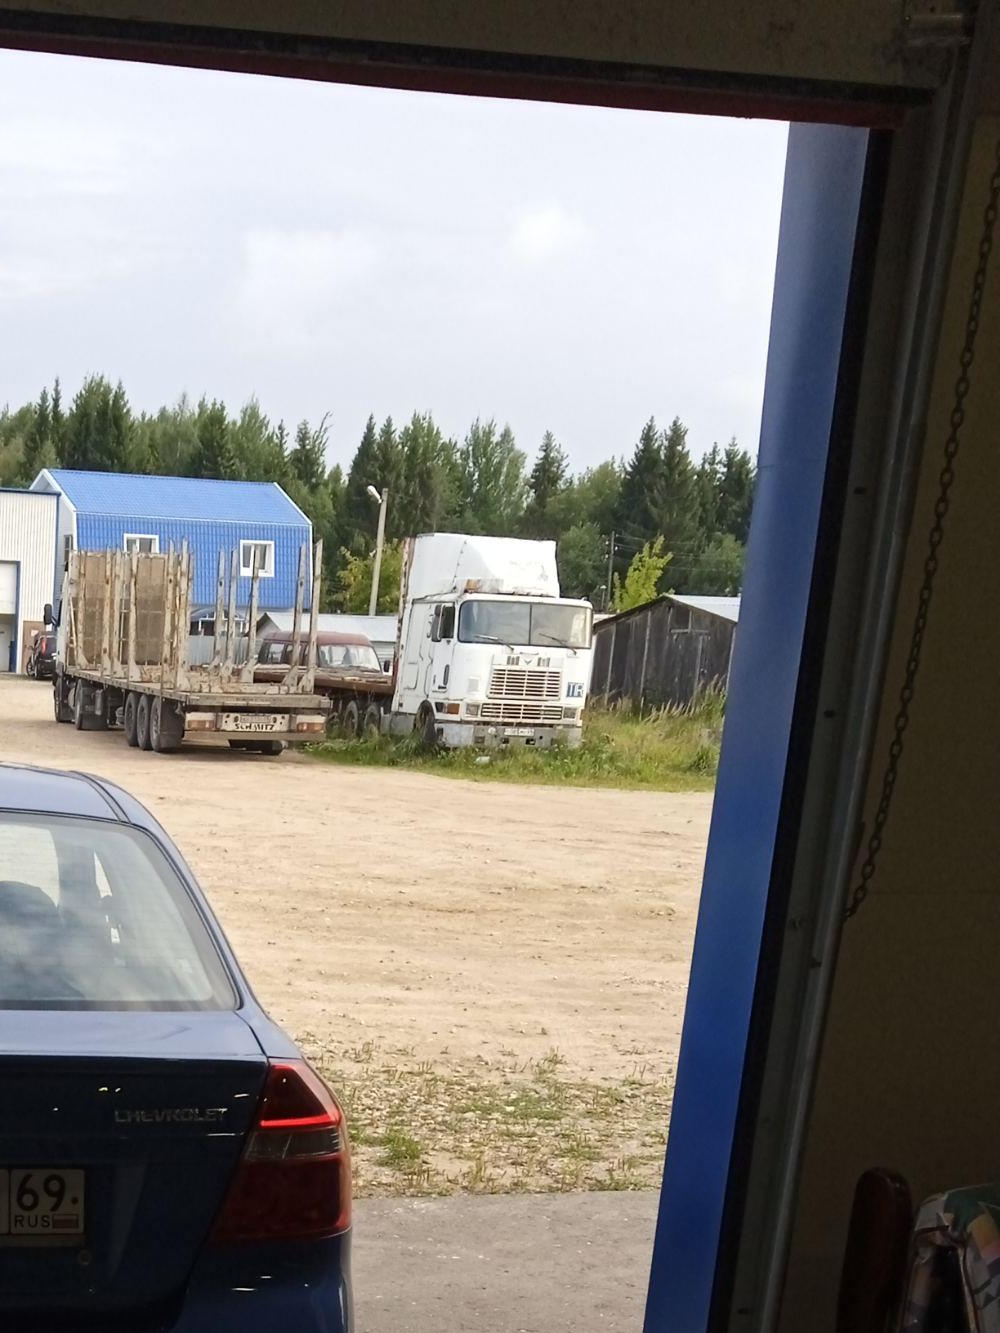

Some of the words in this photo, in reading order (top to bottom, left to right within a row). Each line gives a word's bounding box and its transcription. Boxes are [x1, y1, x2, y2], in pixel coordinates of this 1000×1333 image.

[114, 1107, 229, 1122] CHEVROLET
[16, 1174, 66, 1212] 69
[14, 1214, 51, 1229] RUS
